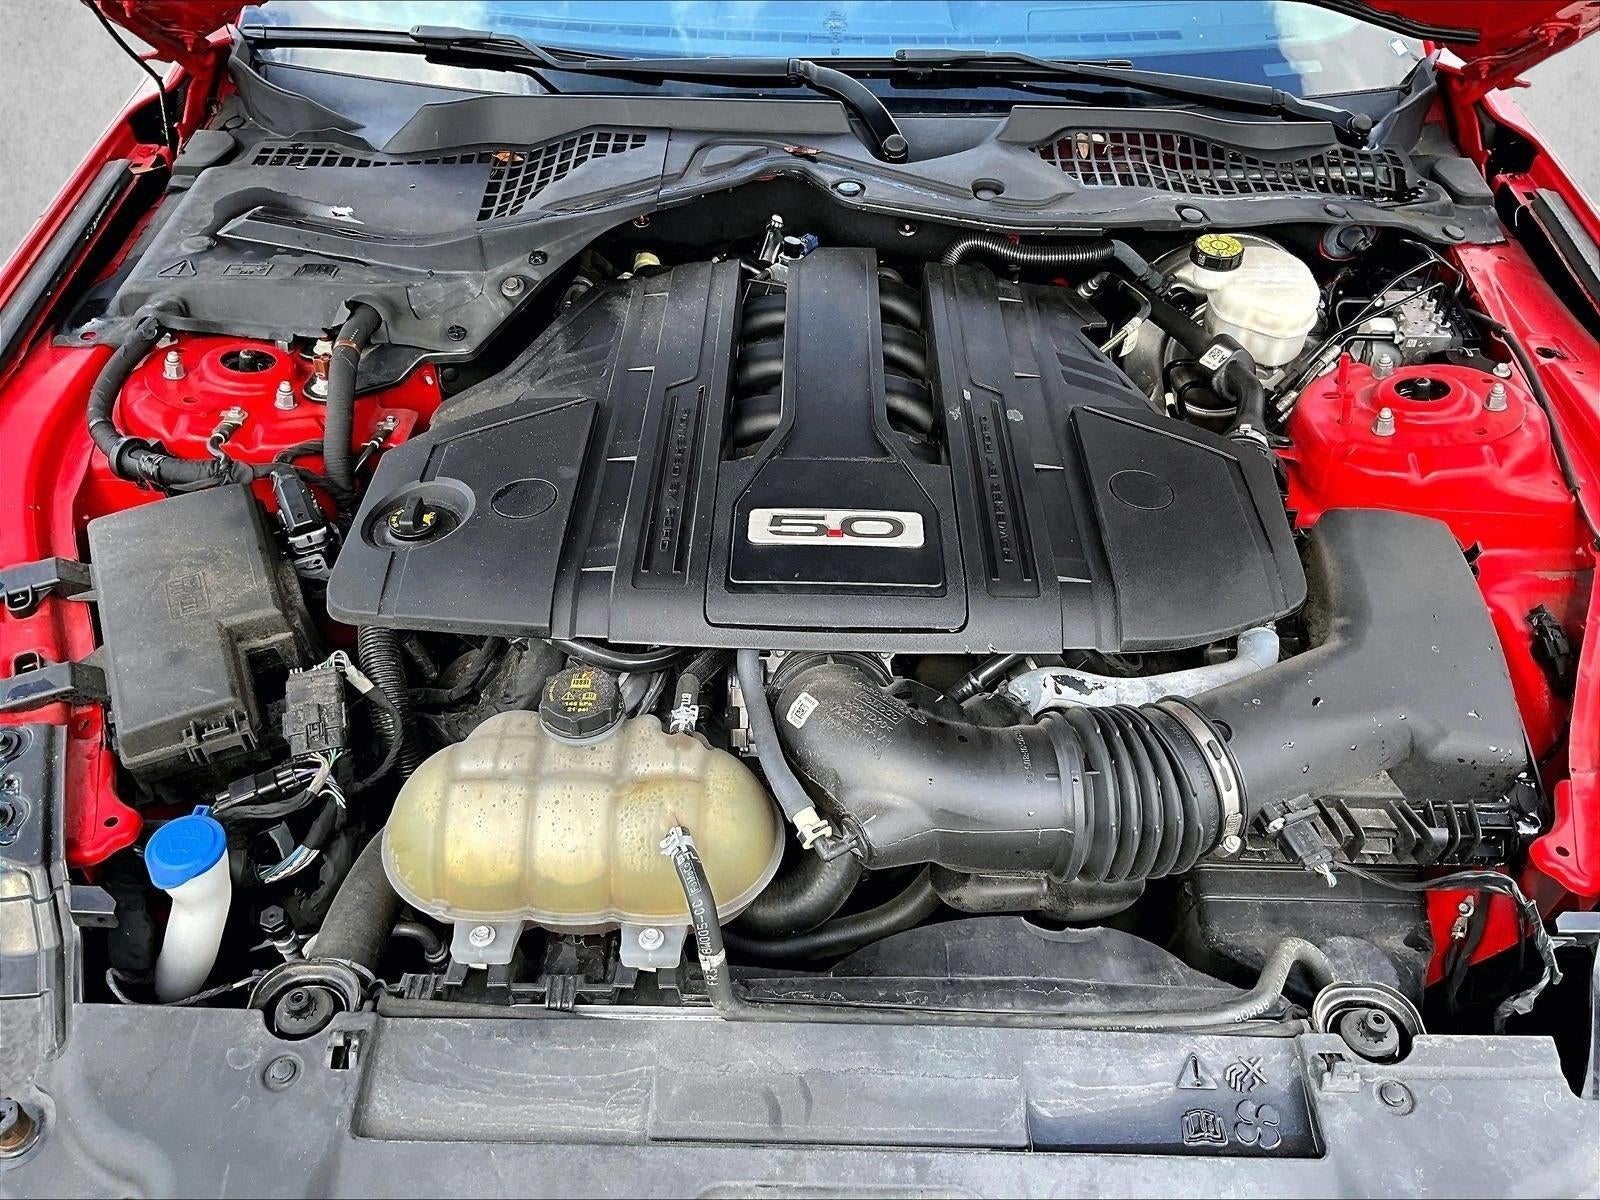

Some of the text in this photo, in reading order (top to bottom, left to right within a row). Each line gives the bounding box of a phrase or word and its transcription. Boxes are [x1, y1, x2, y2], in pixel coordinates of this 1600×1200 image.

[659, 507, 676, 552] FORD
[766, 513, 907, 539] 5.0
[1233, 999, 1271, 1023] ARMOR
